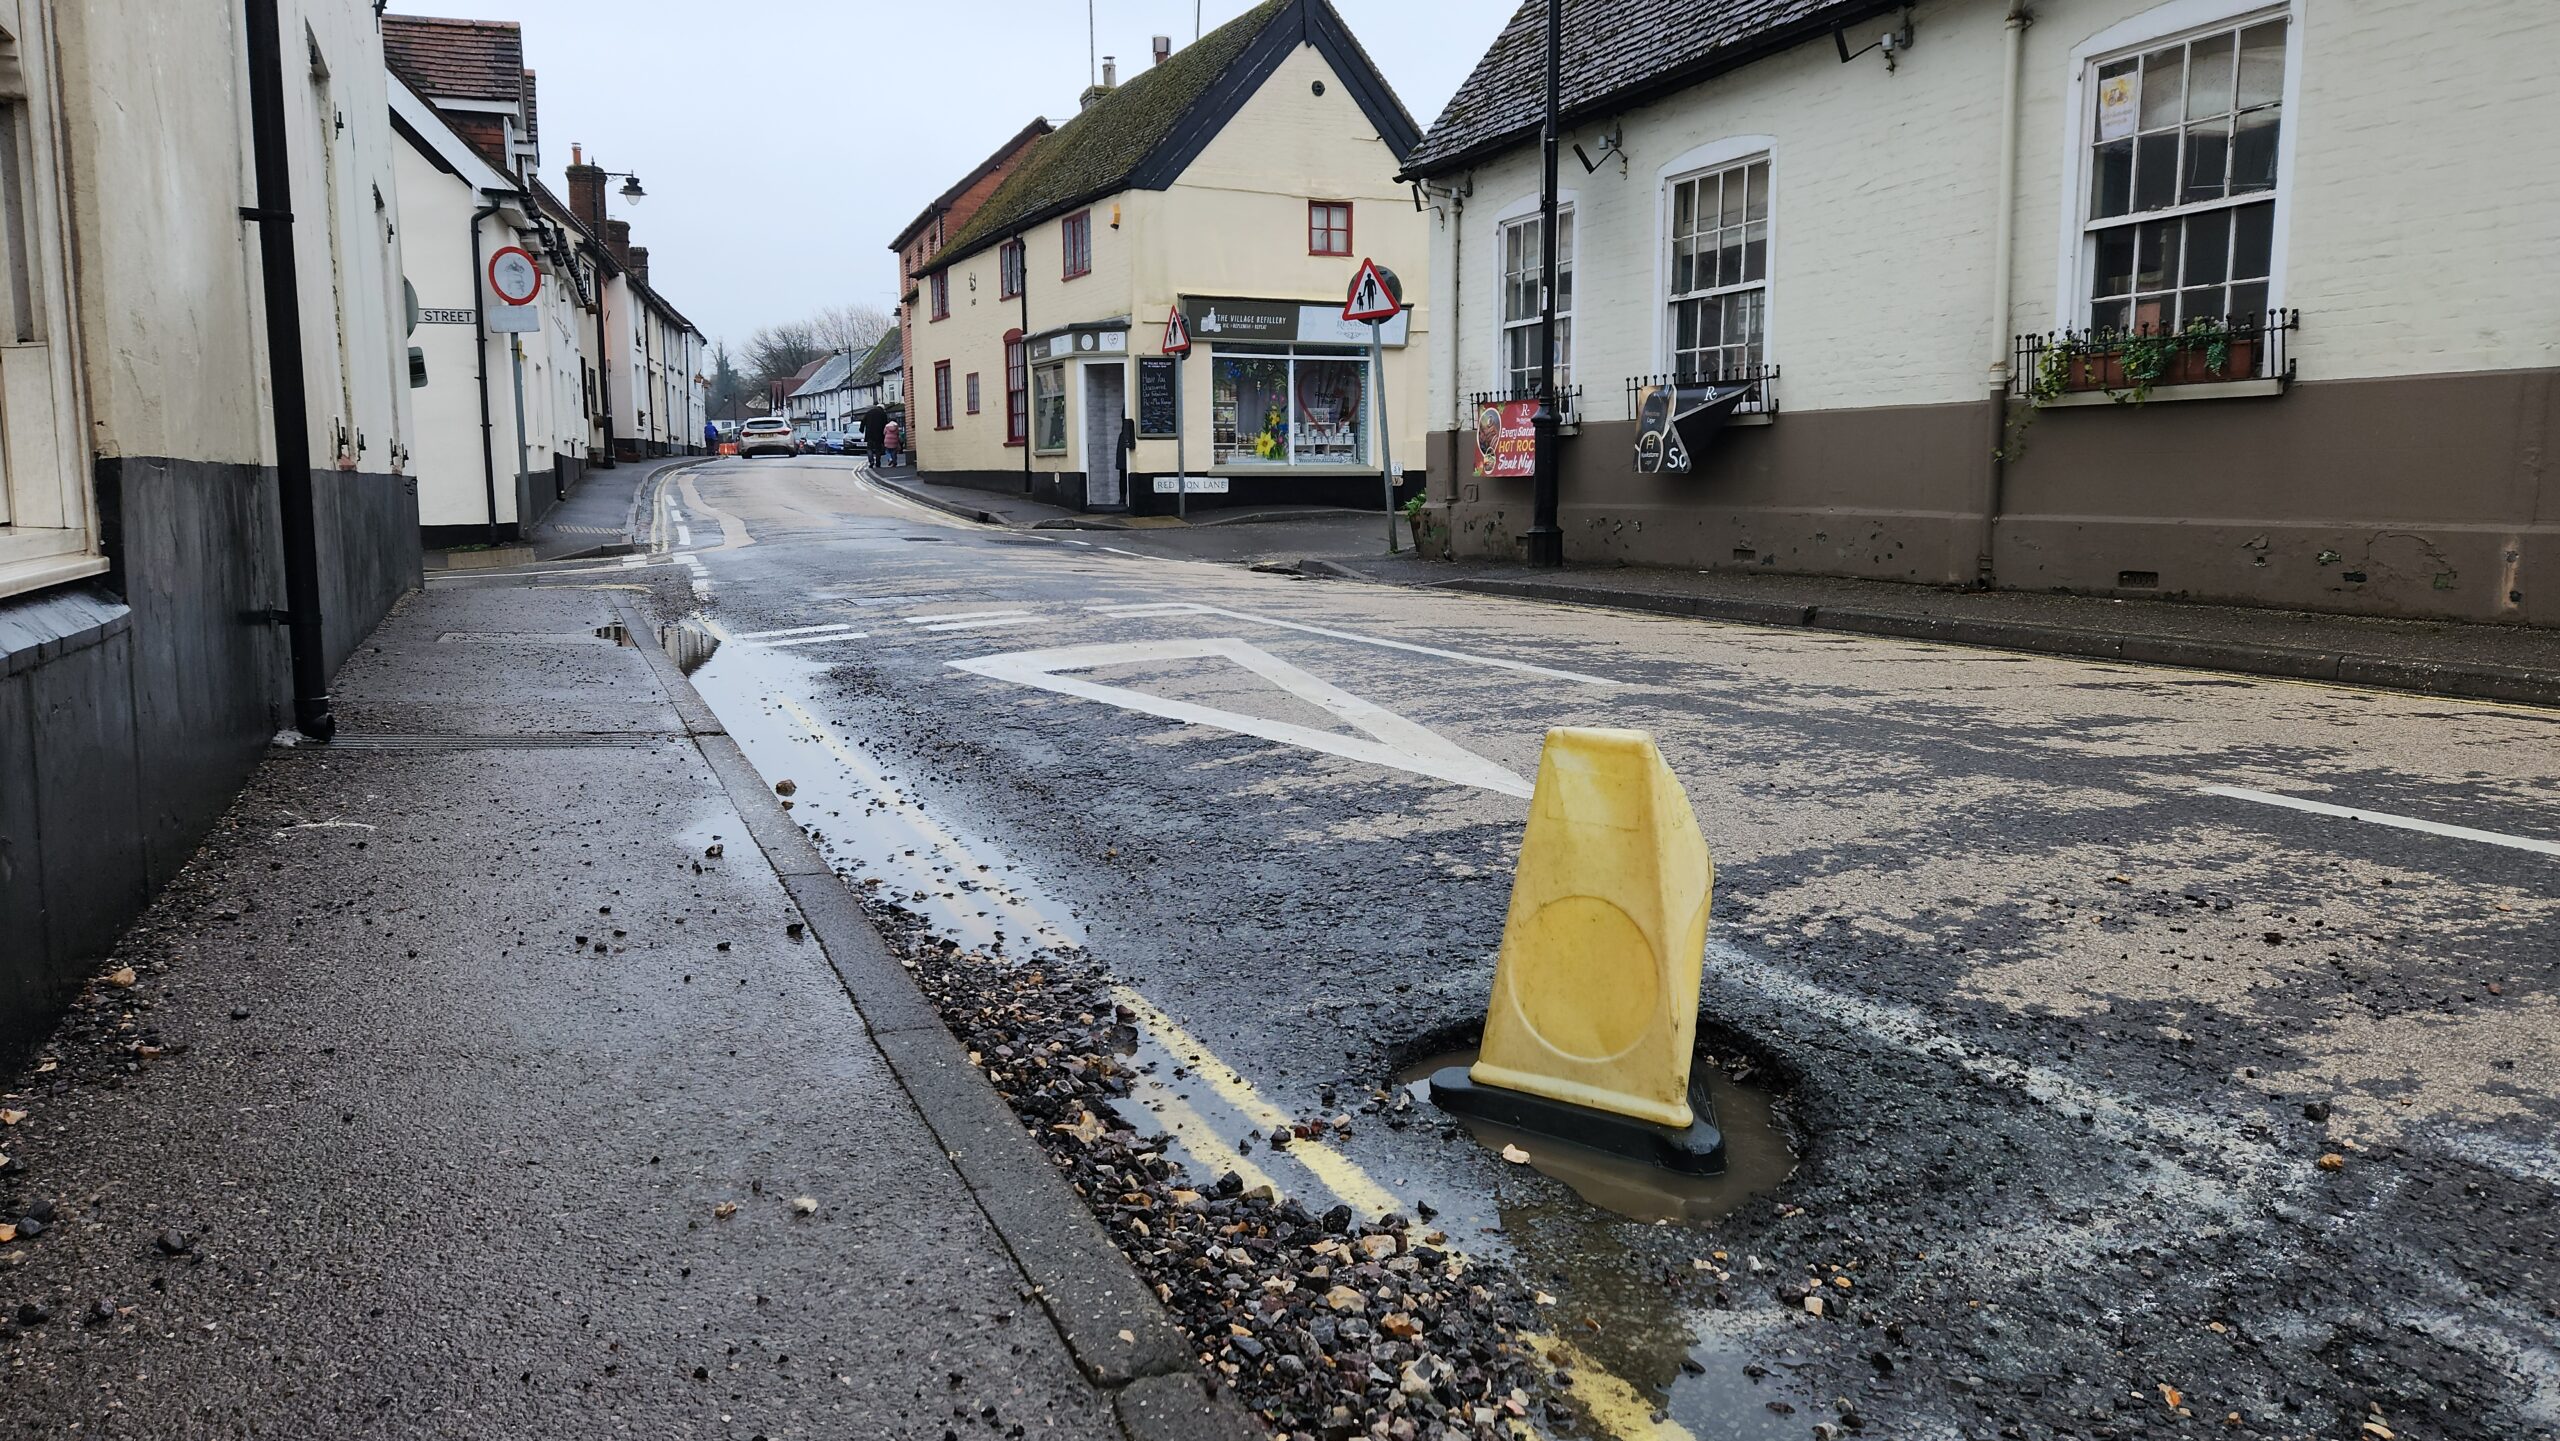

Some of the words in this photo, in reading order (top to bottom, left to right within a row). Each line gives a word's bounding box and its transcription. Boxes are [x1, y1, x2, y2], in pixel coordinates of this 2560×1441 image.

[424, 310, 472, 322] STREET
[1217, 314, 1228, 322] THE
[1230, 315, 1254, 323] VILLAGE
[1256, 316, 1286, 324] REFILLERY
[1501, 428, 1518, 439] Every
[1499, 440, 1515, 453] HOT
[1516, 439, 1535, 452] ROC
[1498, 453, 1517, 470] Steak
[1518, 452, 1535, 473] Nig
[1157, 481, 1175, 489] RED
[1183, 481, 1200, 489] ION
[1203, 481, 1226, 489] LANE
